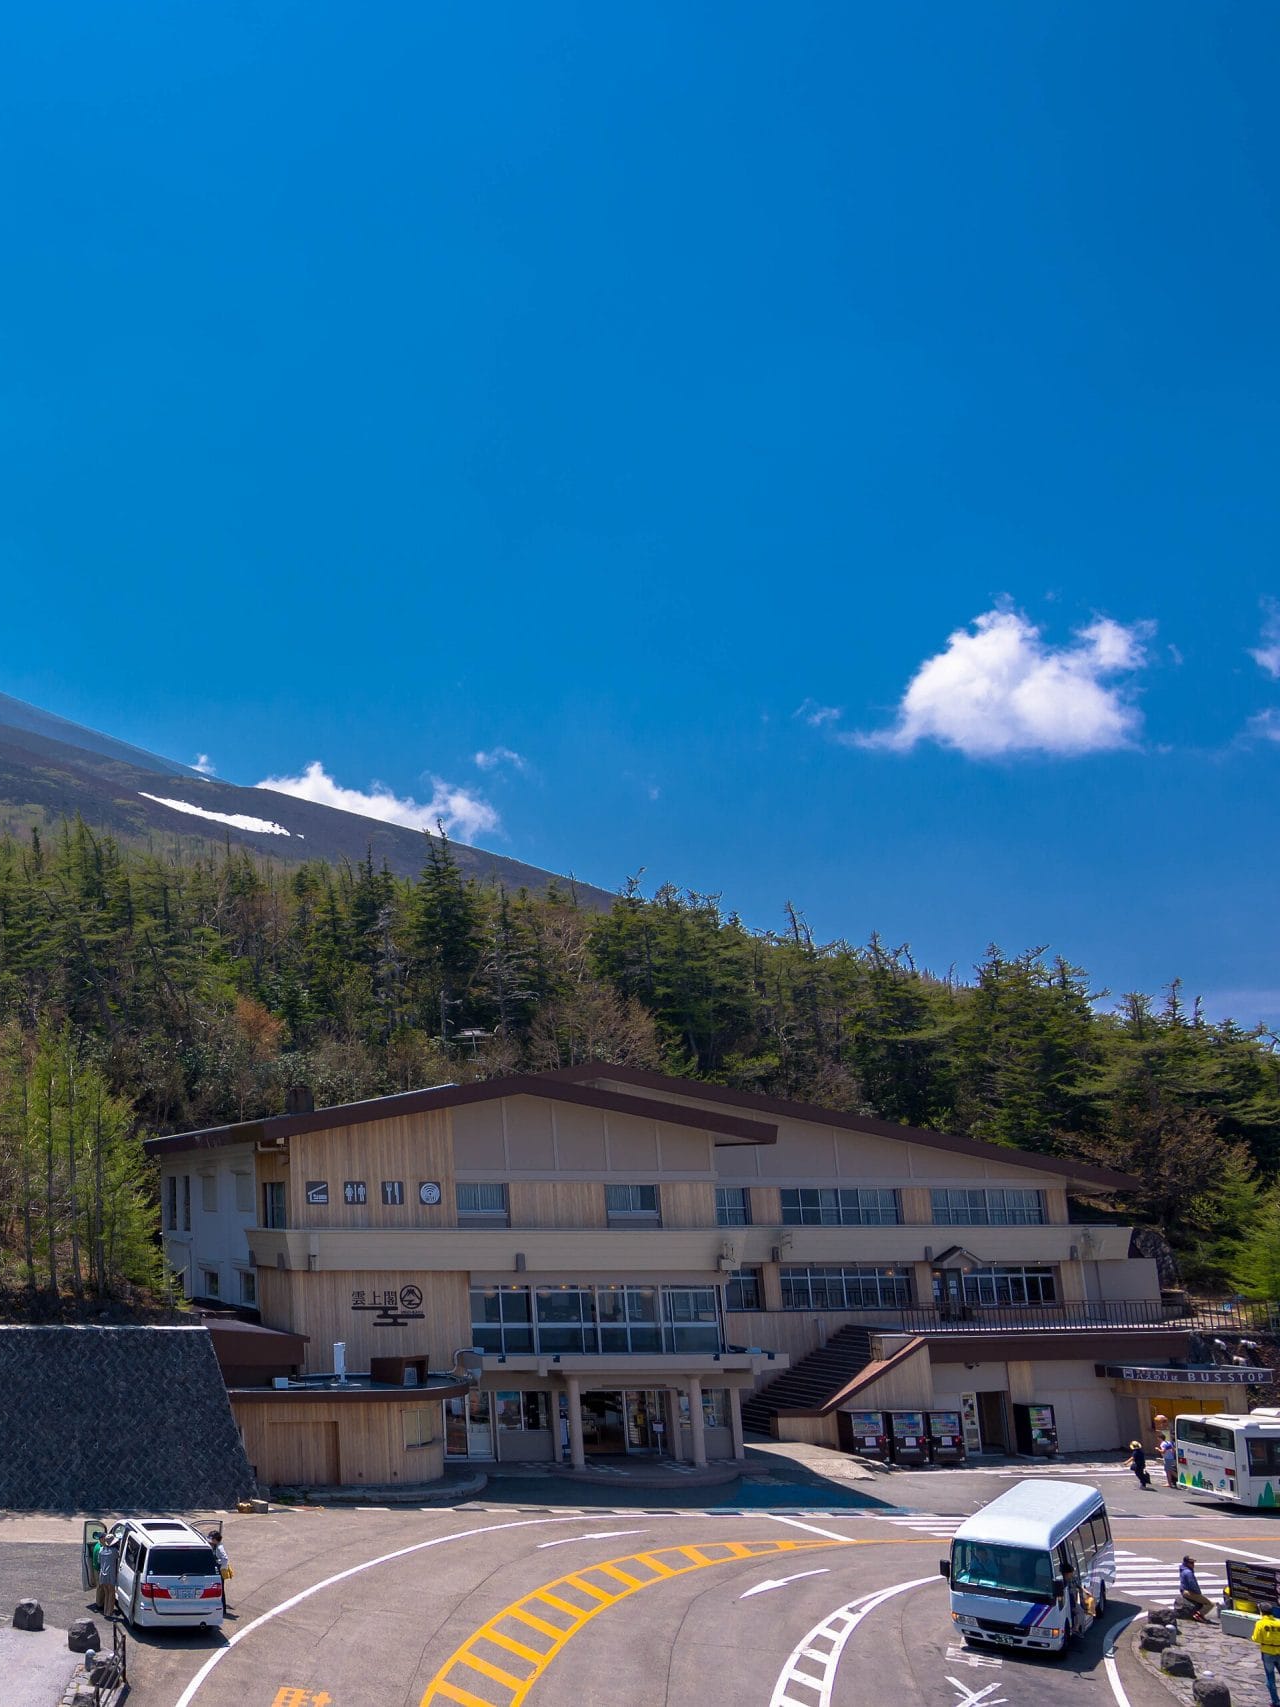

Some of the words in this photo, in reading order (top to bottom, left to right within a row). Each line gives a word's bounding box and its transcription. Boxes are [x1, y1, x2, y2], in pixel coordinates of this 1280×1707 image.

[351, 1290, 398, 1306] 雲上閣
[1187, 1372, 1222, 1382] BUS
[1228, 1372, 1264, 1382] STOP
